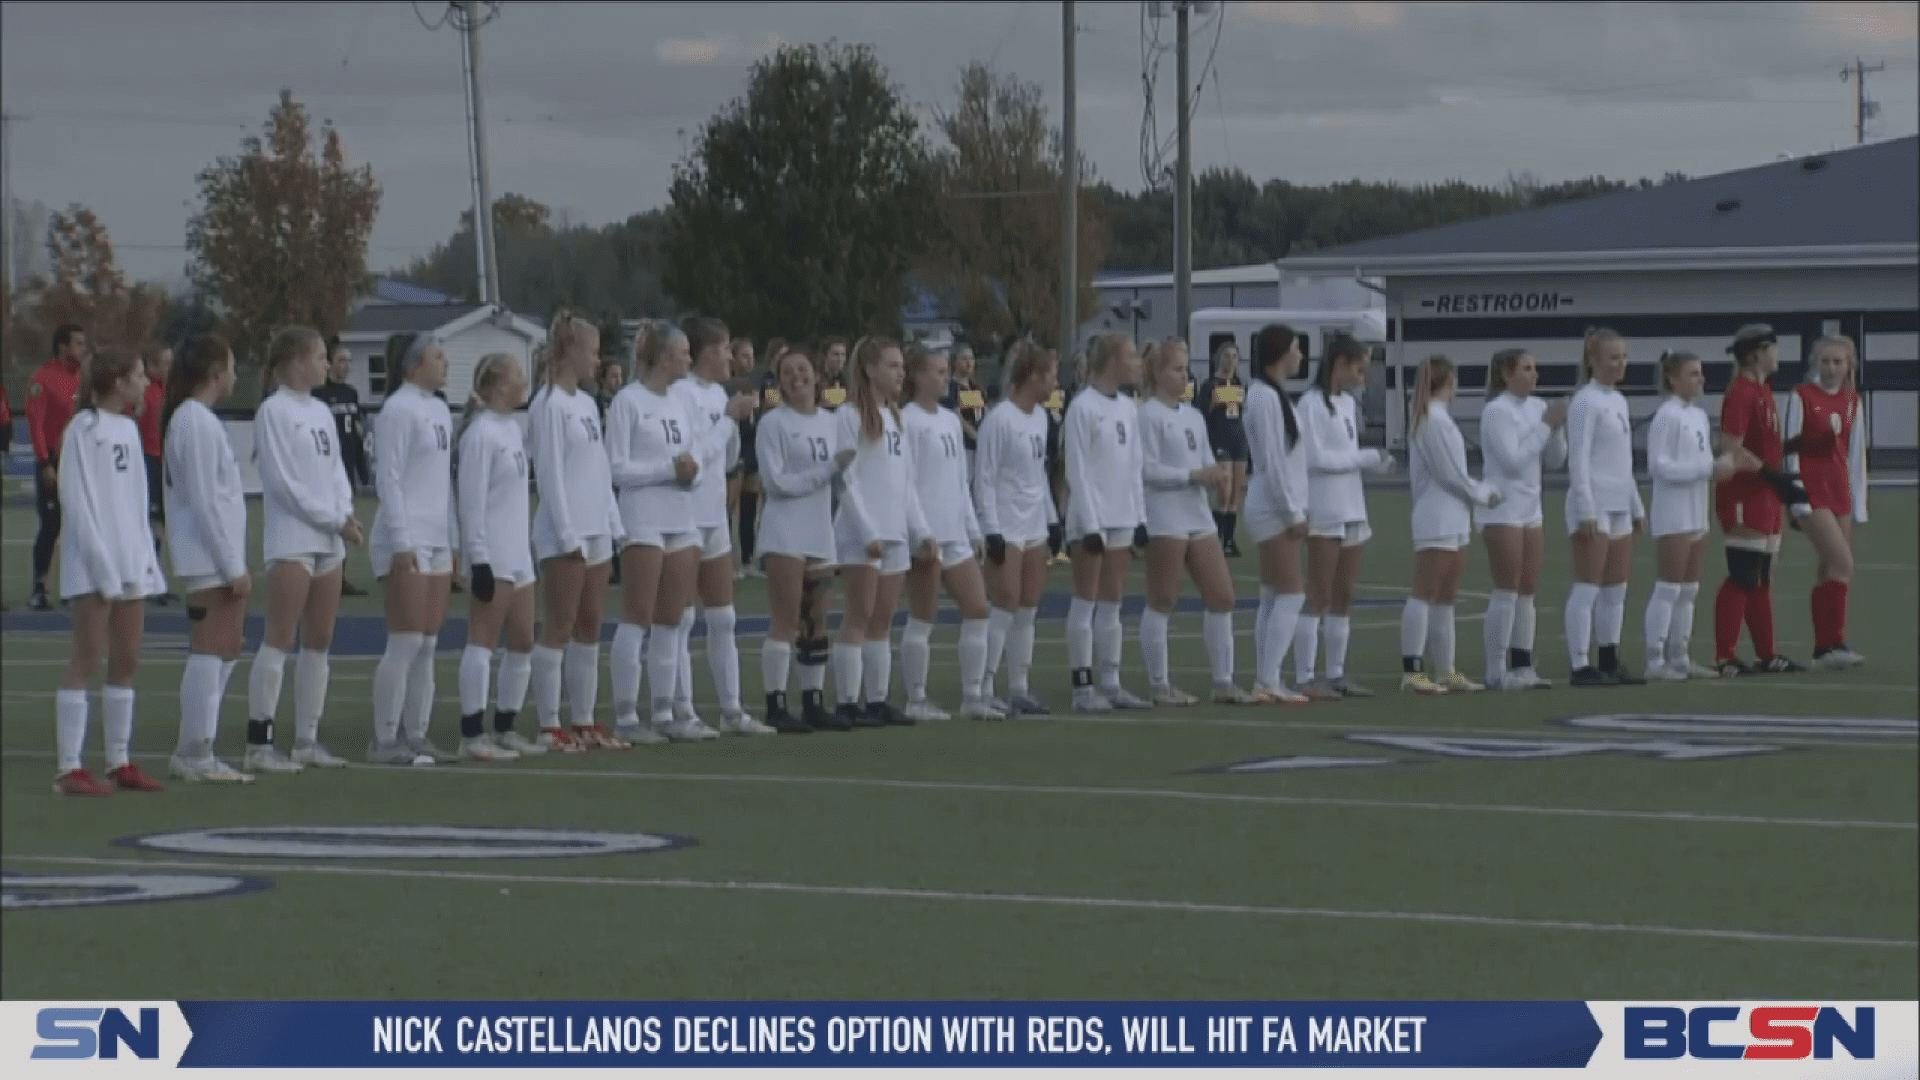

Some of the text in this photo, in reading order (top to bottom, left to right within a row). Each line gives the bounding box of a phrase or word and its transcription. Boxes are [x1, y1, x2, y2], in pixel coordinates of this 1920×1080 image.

[311, 428, 331, 456] 19
[661, 419, 682, 444] 15
[885, 430, 902, 456] 12
[807, 437, 829, 461] 13
